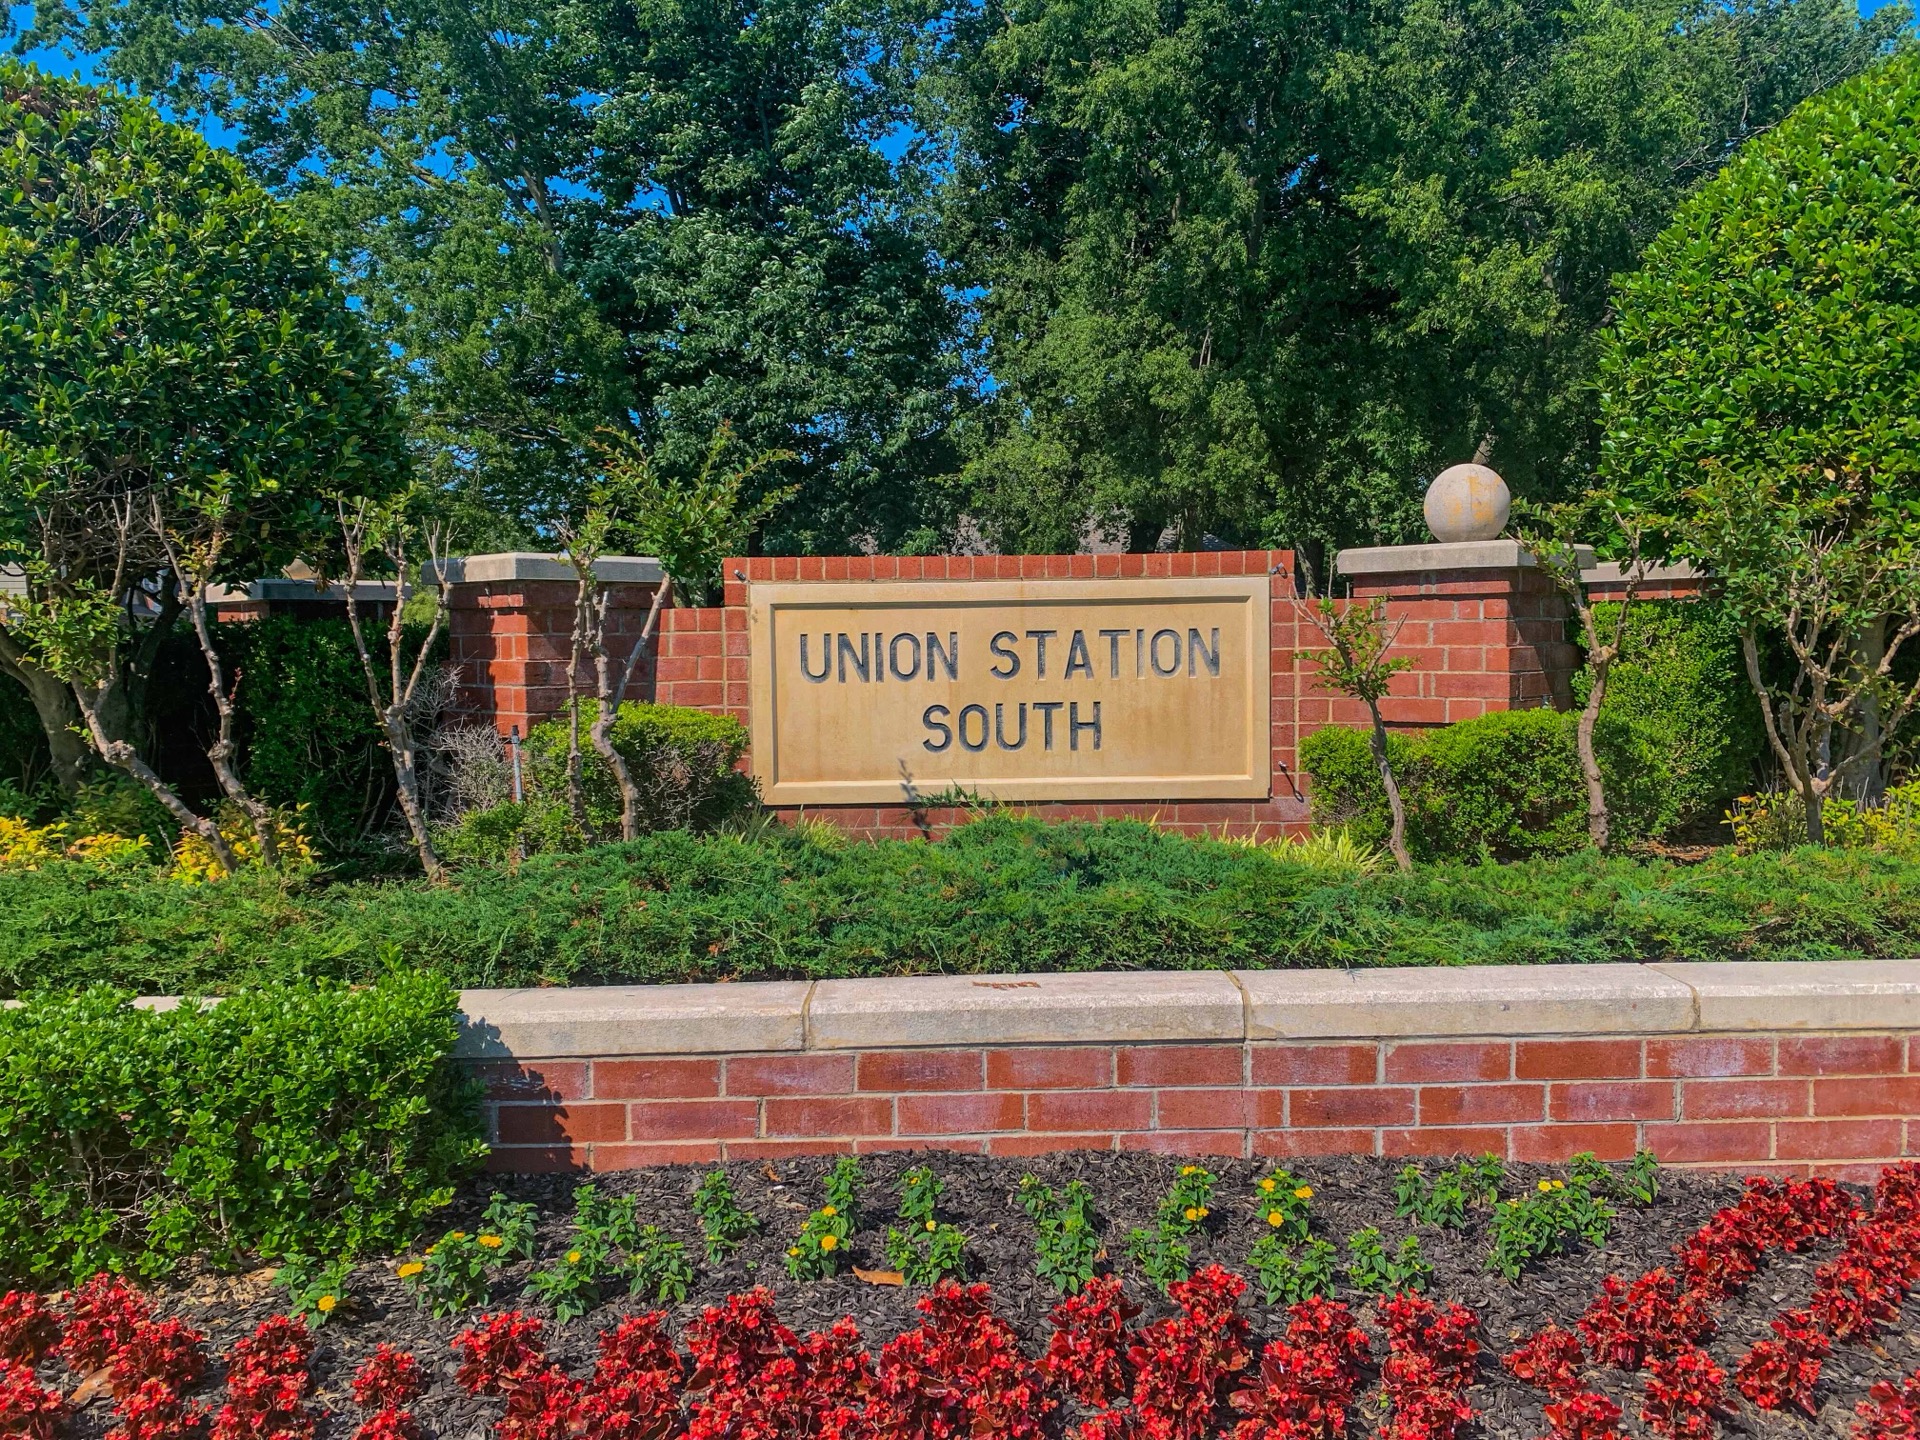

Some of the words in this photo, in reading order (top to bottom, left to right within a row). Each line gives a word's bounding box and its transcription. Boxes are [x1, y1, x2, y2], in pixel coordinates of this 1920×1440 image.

[800, 631, 958, 683] UNION
[990, 627, 1220, 680] STATION
[922, 701, 1102, 753] SOUTH
